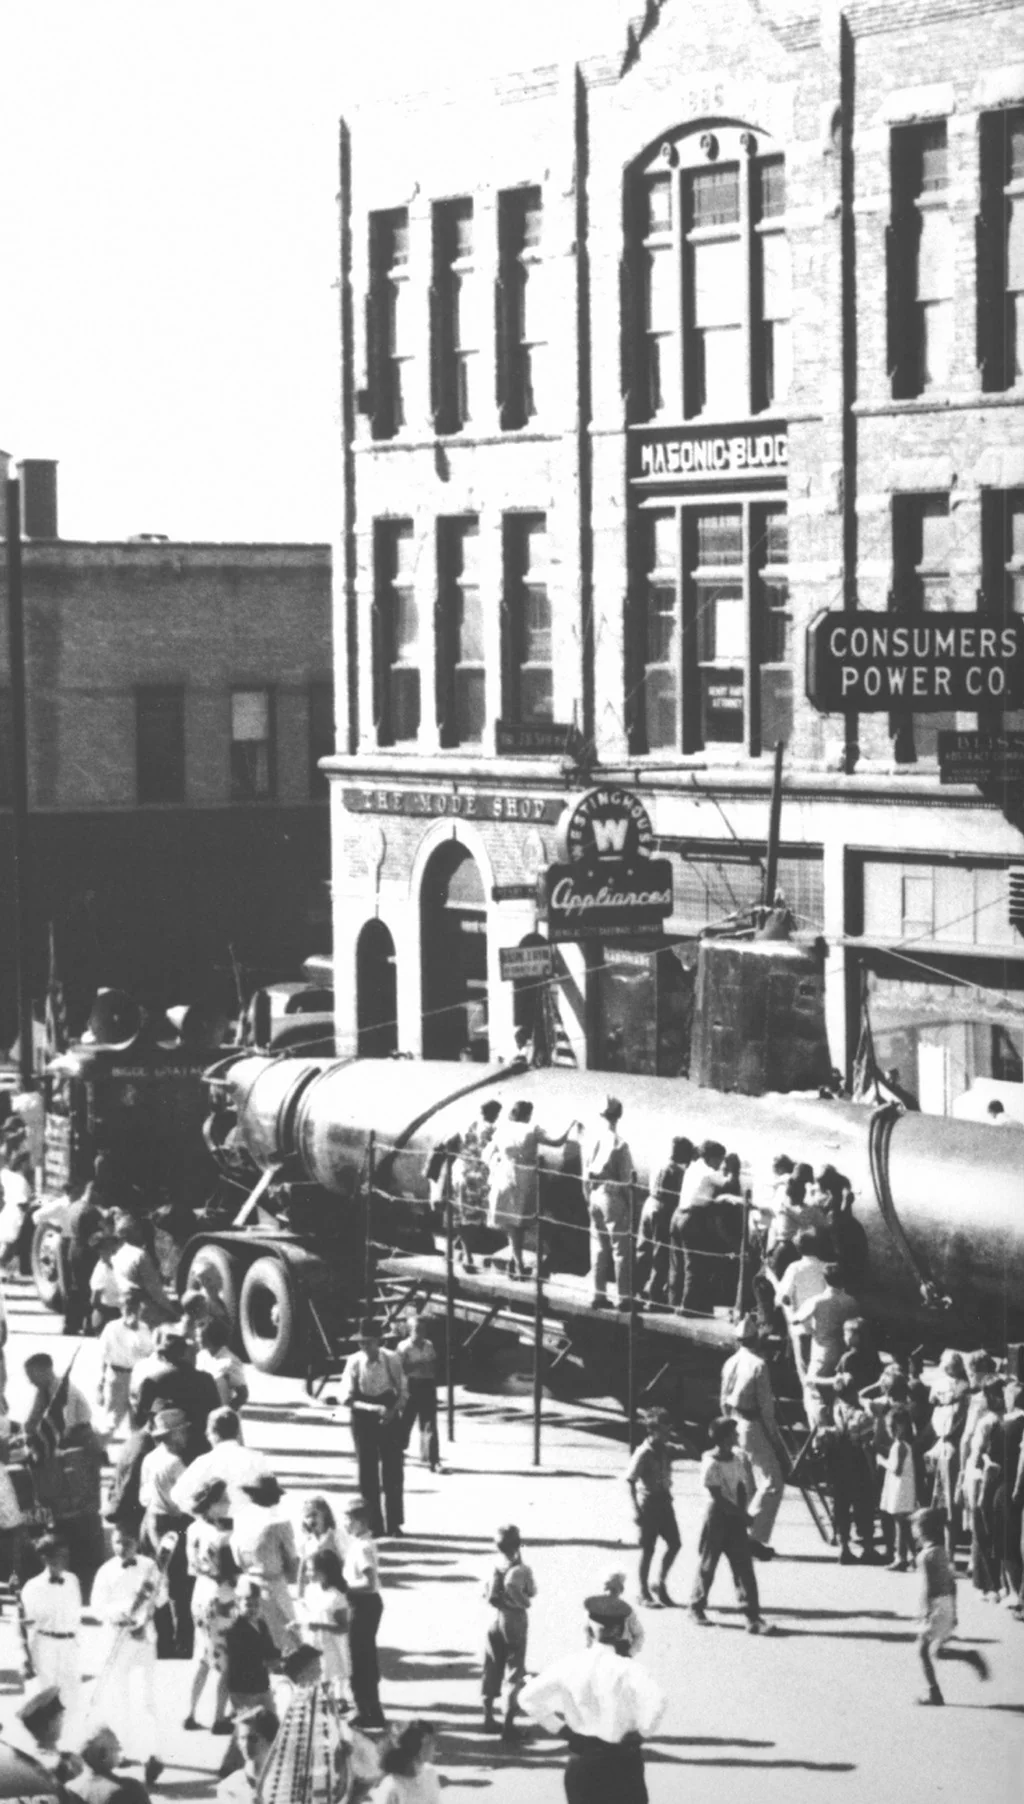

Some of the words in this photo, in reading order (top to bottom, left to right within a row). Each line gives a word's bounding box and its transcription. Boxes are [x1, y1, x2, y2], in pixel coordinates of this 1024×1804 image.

[641, 439, 725, 473] MASONIC
[730, 434, 788, 467] BLDG
[830, 627, 1018, 658] CONSUMERS
[840, 666, 952, 696] POWER
[964, 666, 1012, 696] CO.
[362, 790, 403, 811] THE
[492, 796, 547, 819] SHOP
[570, 790, 653, 861] WESTINGHOUSE
[549, 876, 672, 917] Appliances
